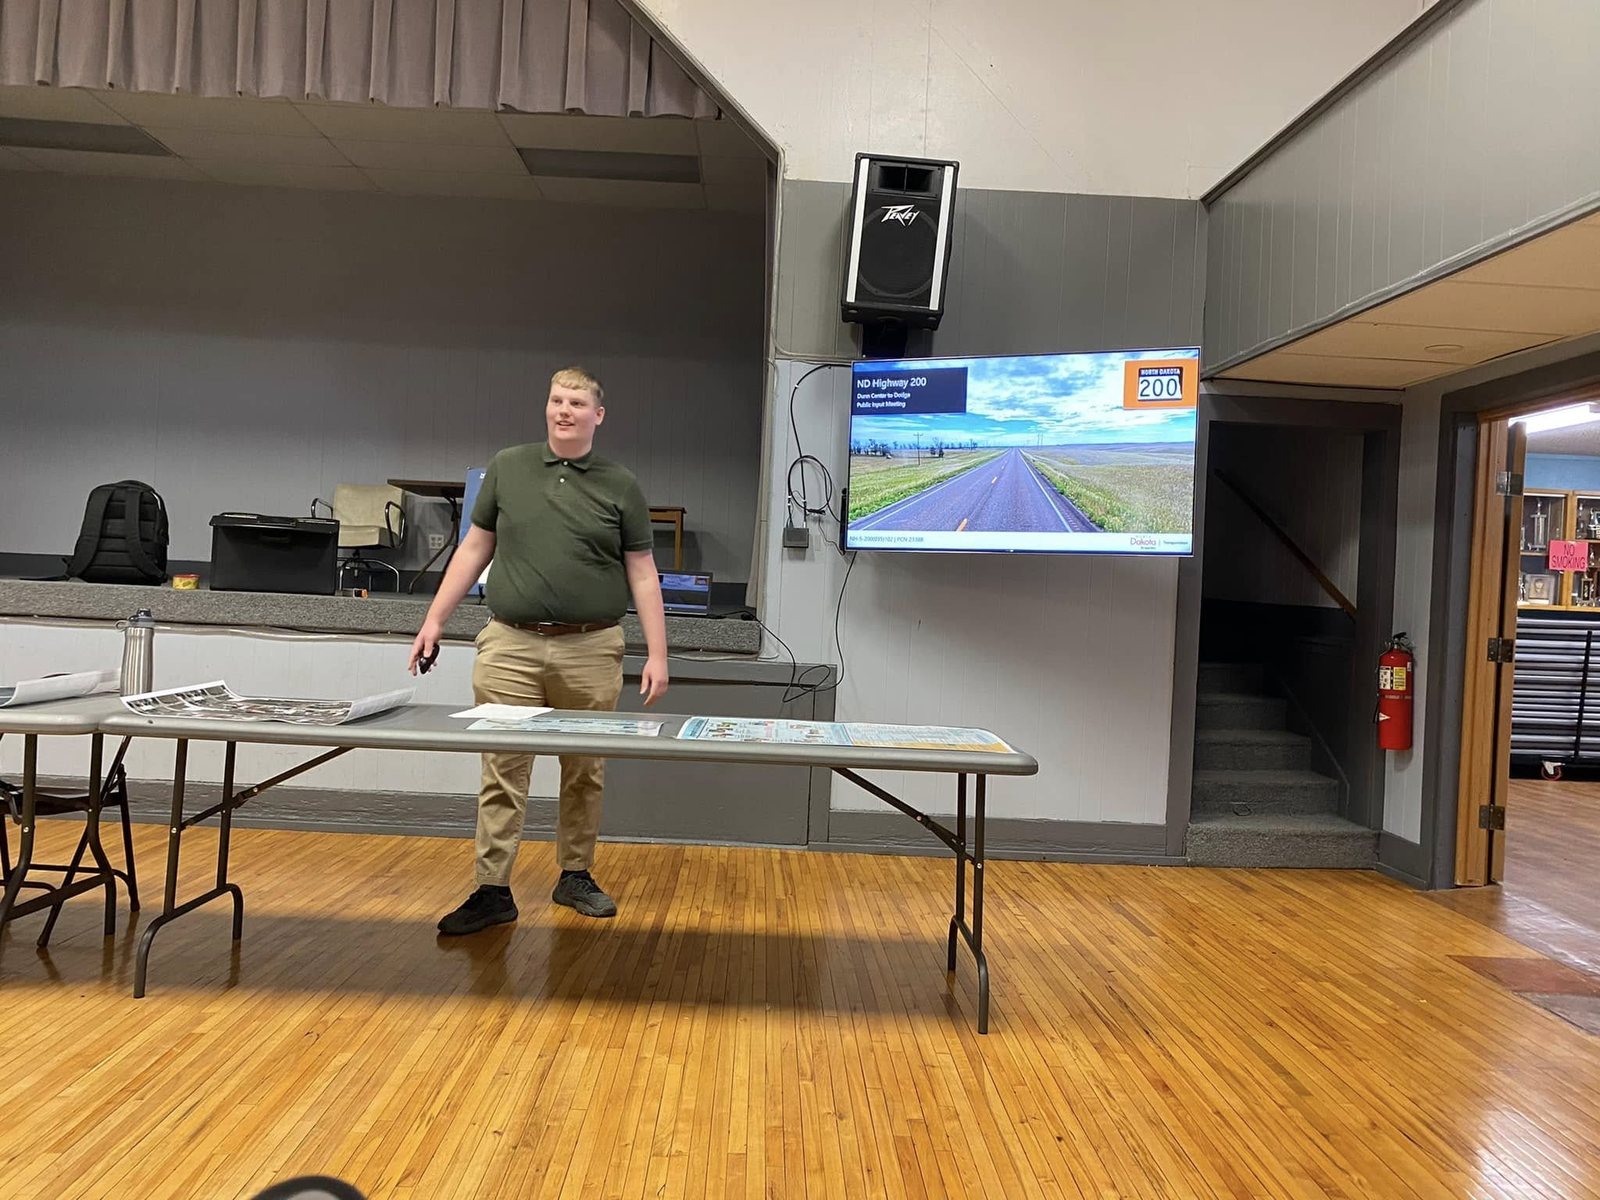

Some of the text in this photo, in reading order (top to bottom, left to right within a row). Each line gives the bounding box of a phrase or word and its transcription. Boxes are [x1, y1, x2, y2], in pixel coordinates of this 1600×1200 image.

[857, 377, 927, 390] ND Highway 200
[1139, 378, 1178, 397] 200
[893, 391, 911, 399] Dodge
[885, 400, 906, 408] Meeting
[1130, 537, 1157, 546] Dakota
[1563, 544, 1575, 557] NO
[1551, 555, 1586, 569] SMOKING
